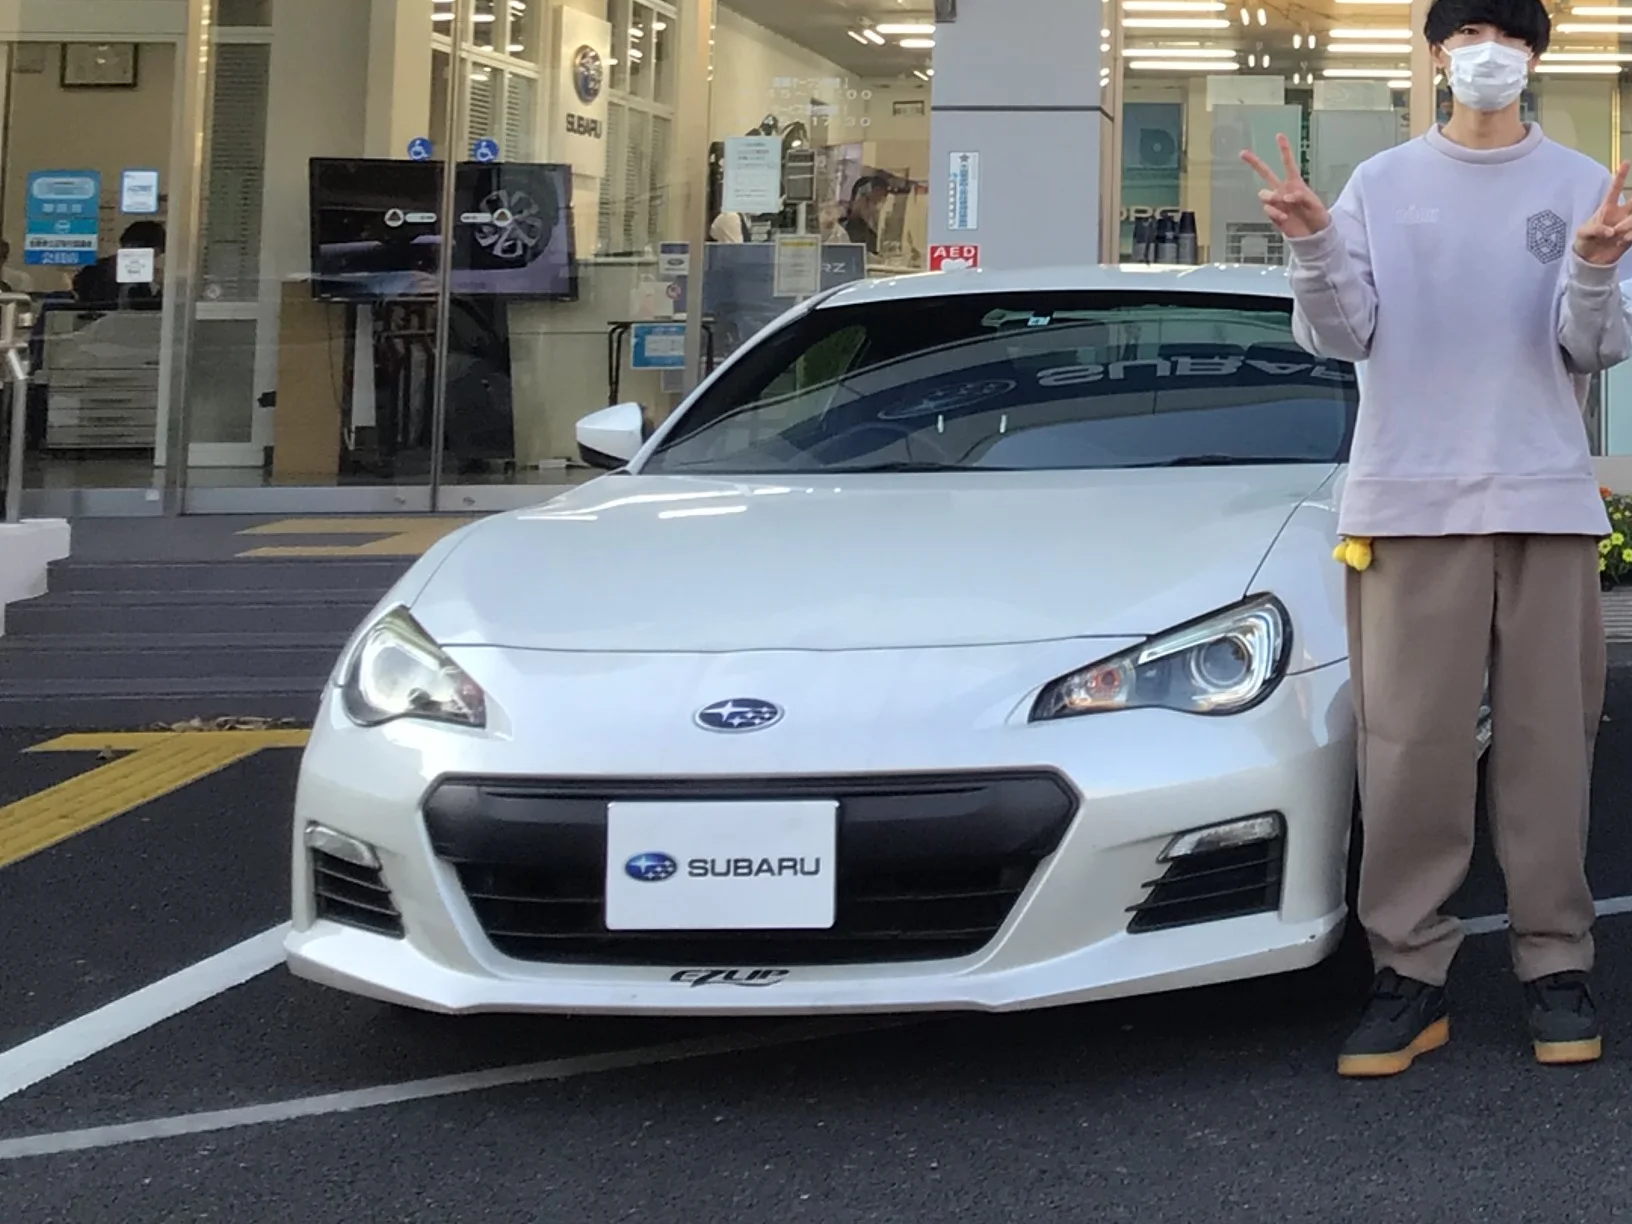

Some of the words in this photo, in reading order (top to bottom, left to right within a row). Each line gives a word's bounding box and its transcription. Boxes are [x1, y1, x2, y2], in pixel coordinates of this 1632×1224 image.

[566, 112, 602, 139] SUBARU
[933, 246, 976, 258] AED
[687, 857, 821, 877] SUBARU
